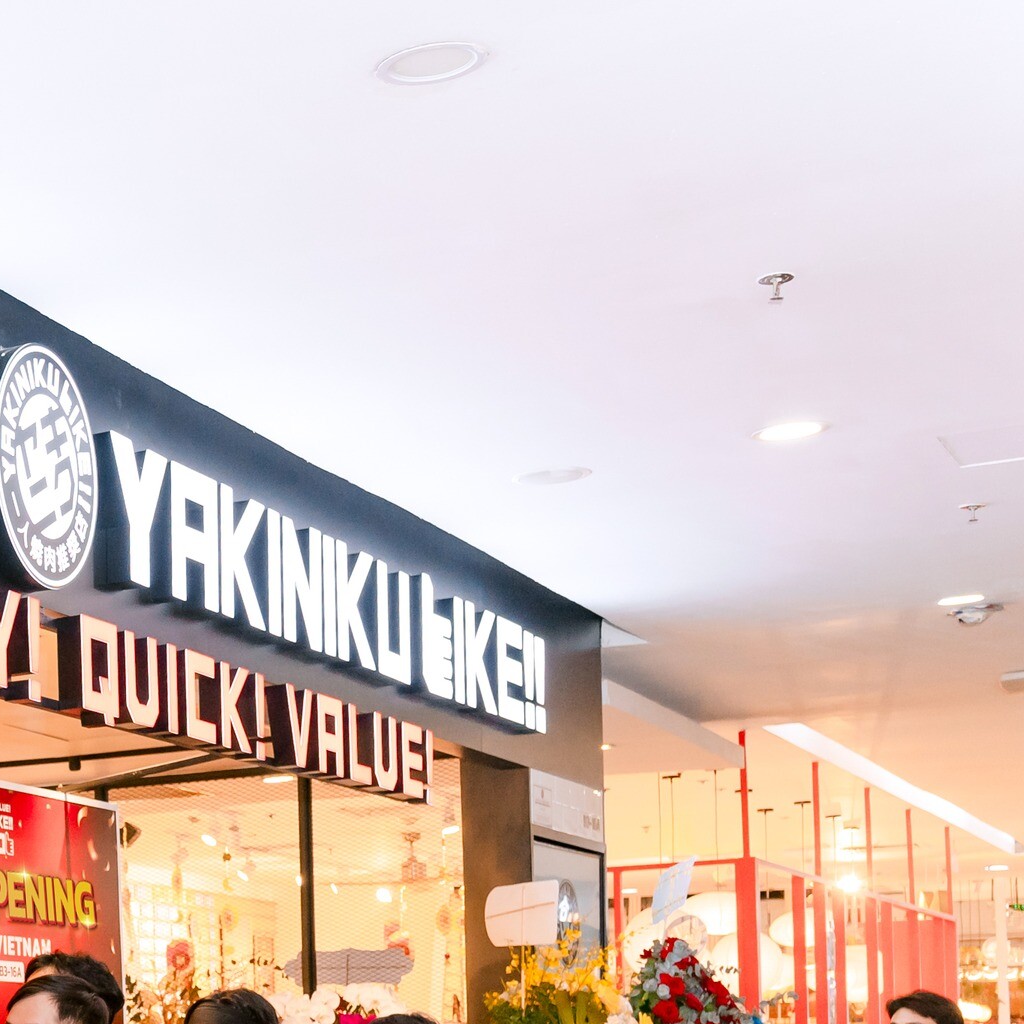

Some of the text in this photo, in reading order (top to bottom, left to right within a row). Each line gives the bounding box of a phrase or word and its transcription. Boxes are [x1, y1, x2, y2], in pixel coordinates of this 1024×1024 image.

[0, 357, 60, 484] YAKINIKU
[108, 430, 411, 684] YAKINIKU
[81, 614, 266, 761] QUICK!
[286, 687, 435, 804] VALUE!
[0, 965, 22, 978] B3-16A
